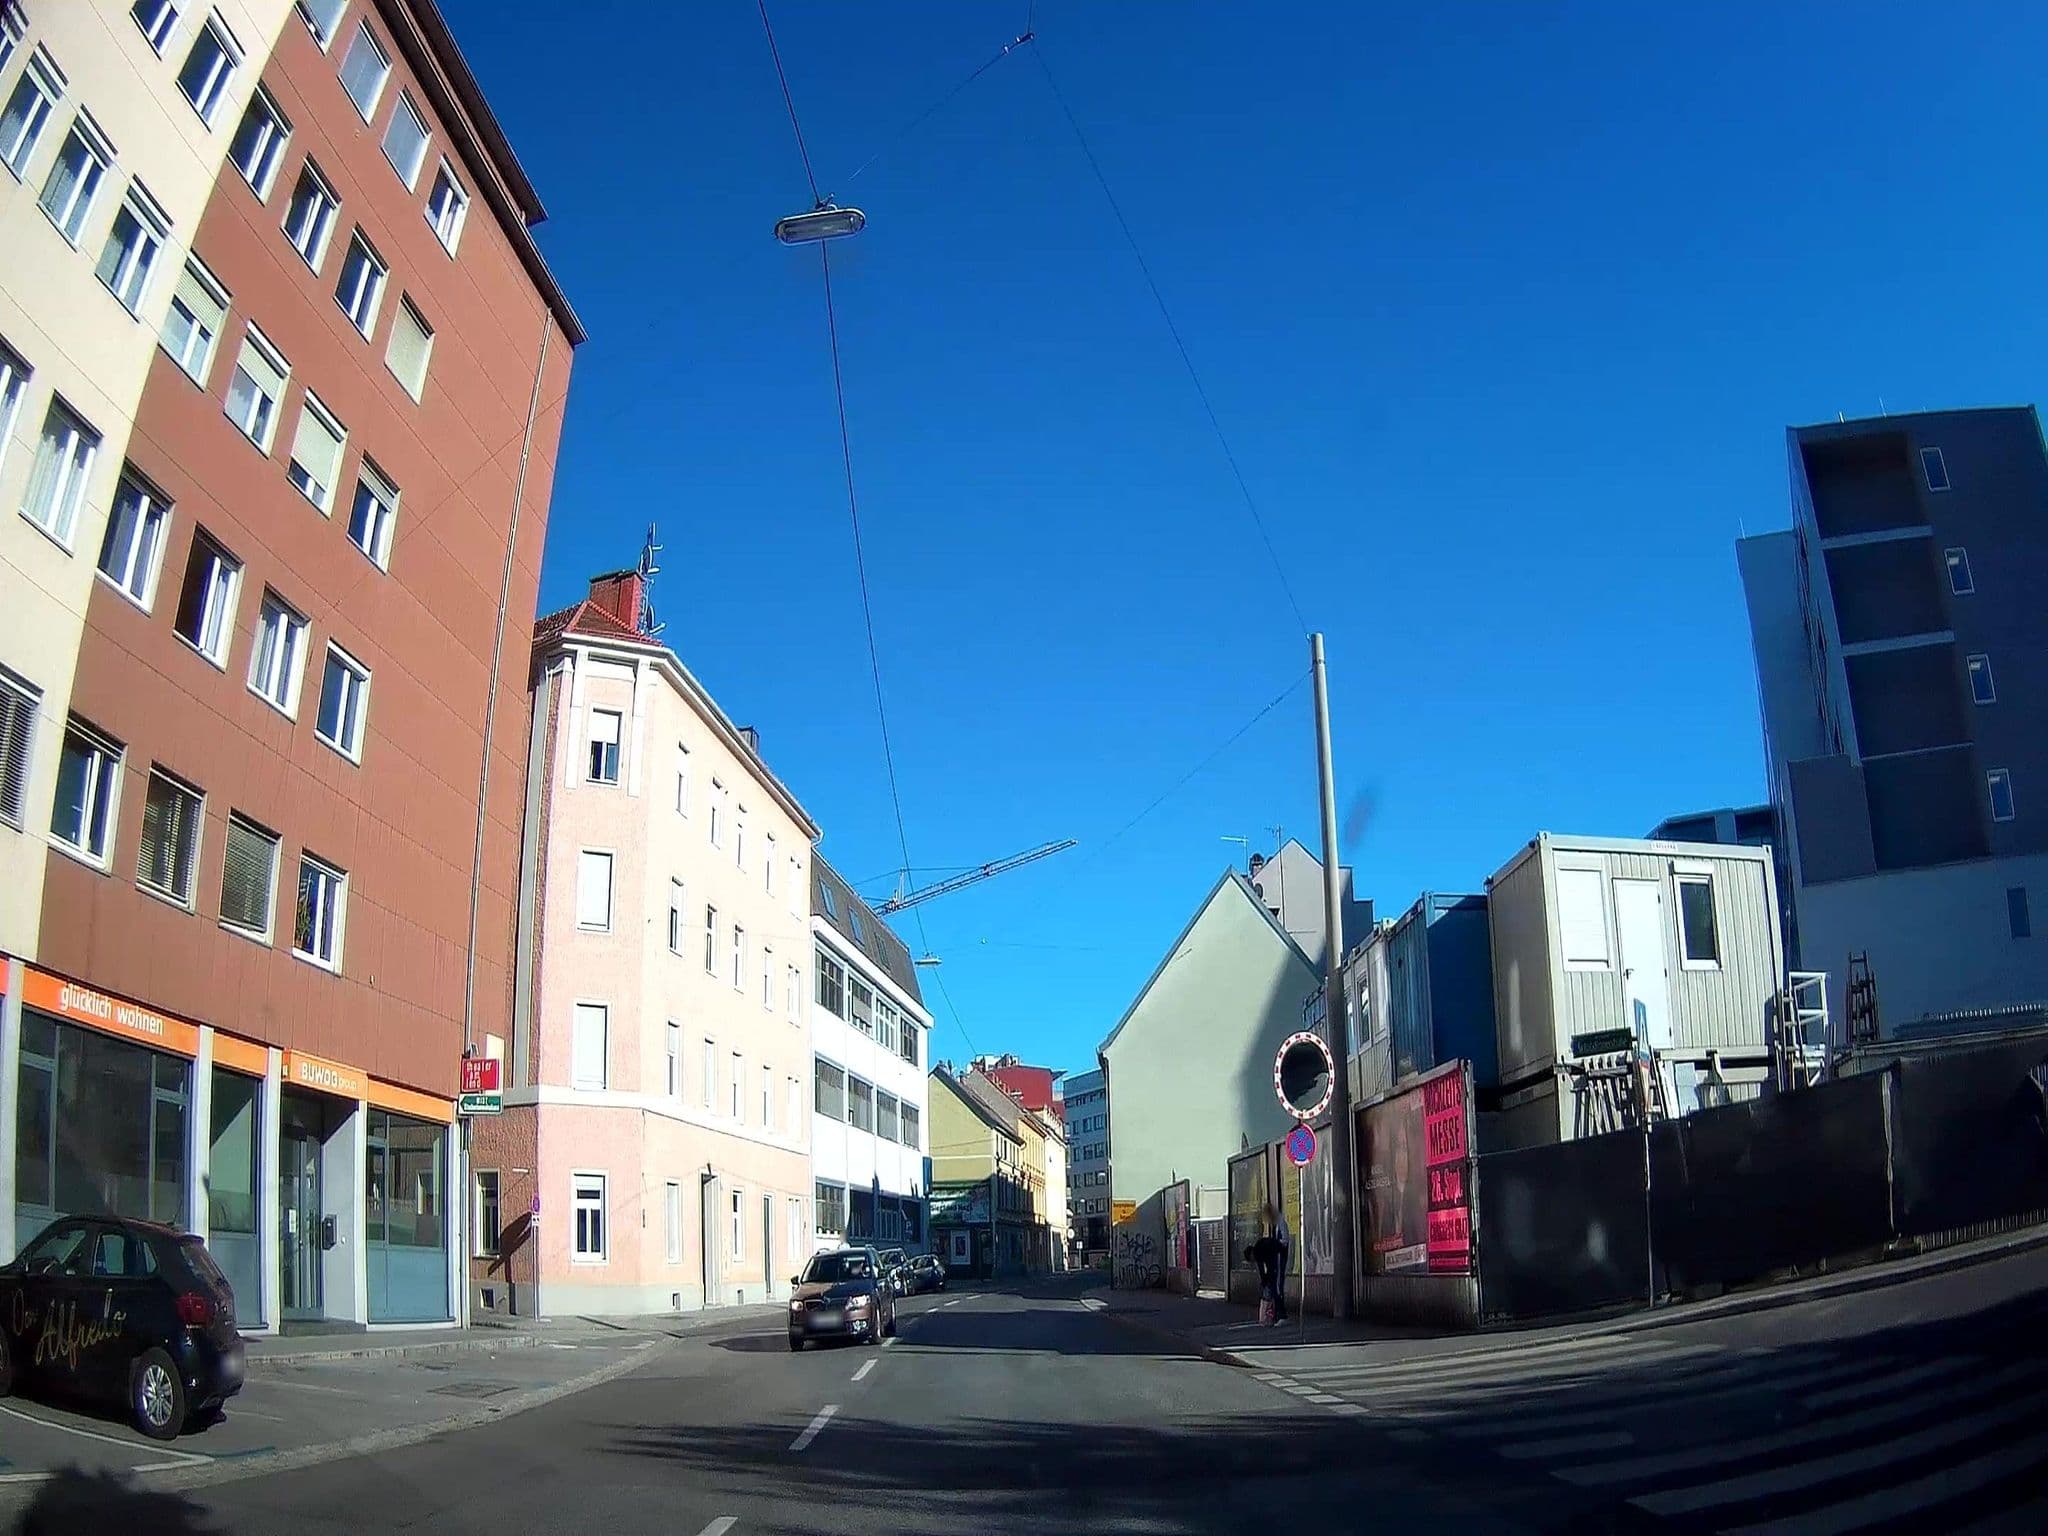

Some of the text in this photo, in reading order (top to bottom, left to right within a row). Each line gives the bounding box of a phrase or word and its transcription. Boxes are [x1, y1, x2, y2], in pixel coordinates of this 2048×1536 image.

[61, 983, 163, 1036] glücklich wohnen
[302, 1061, 338, 1088] BUWOG
[1428, 1116, 1460, 1158] MESSE
